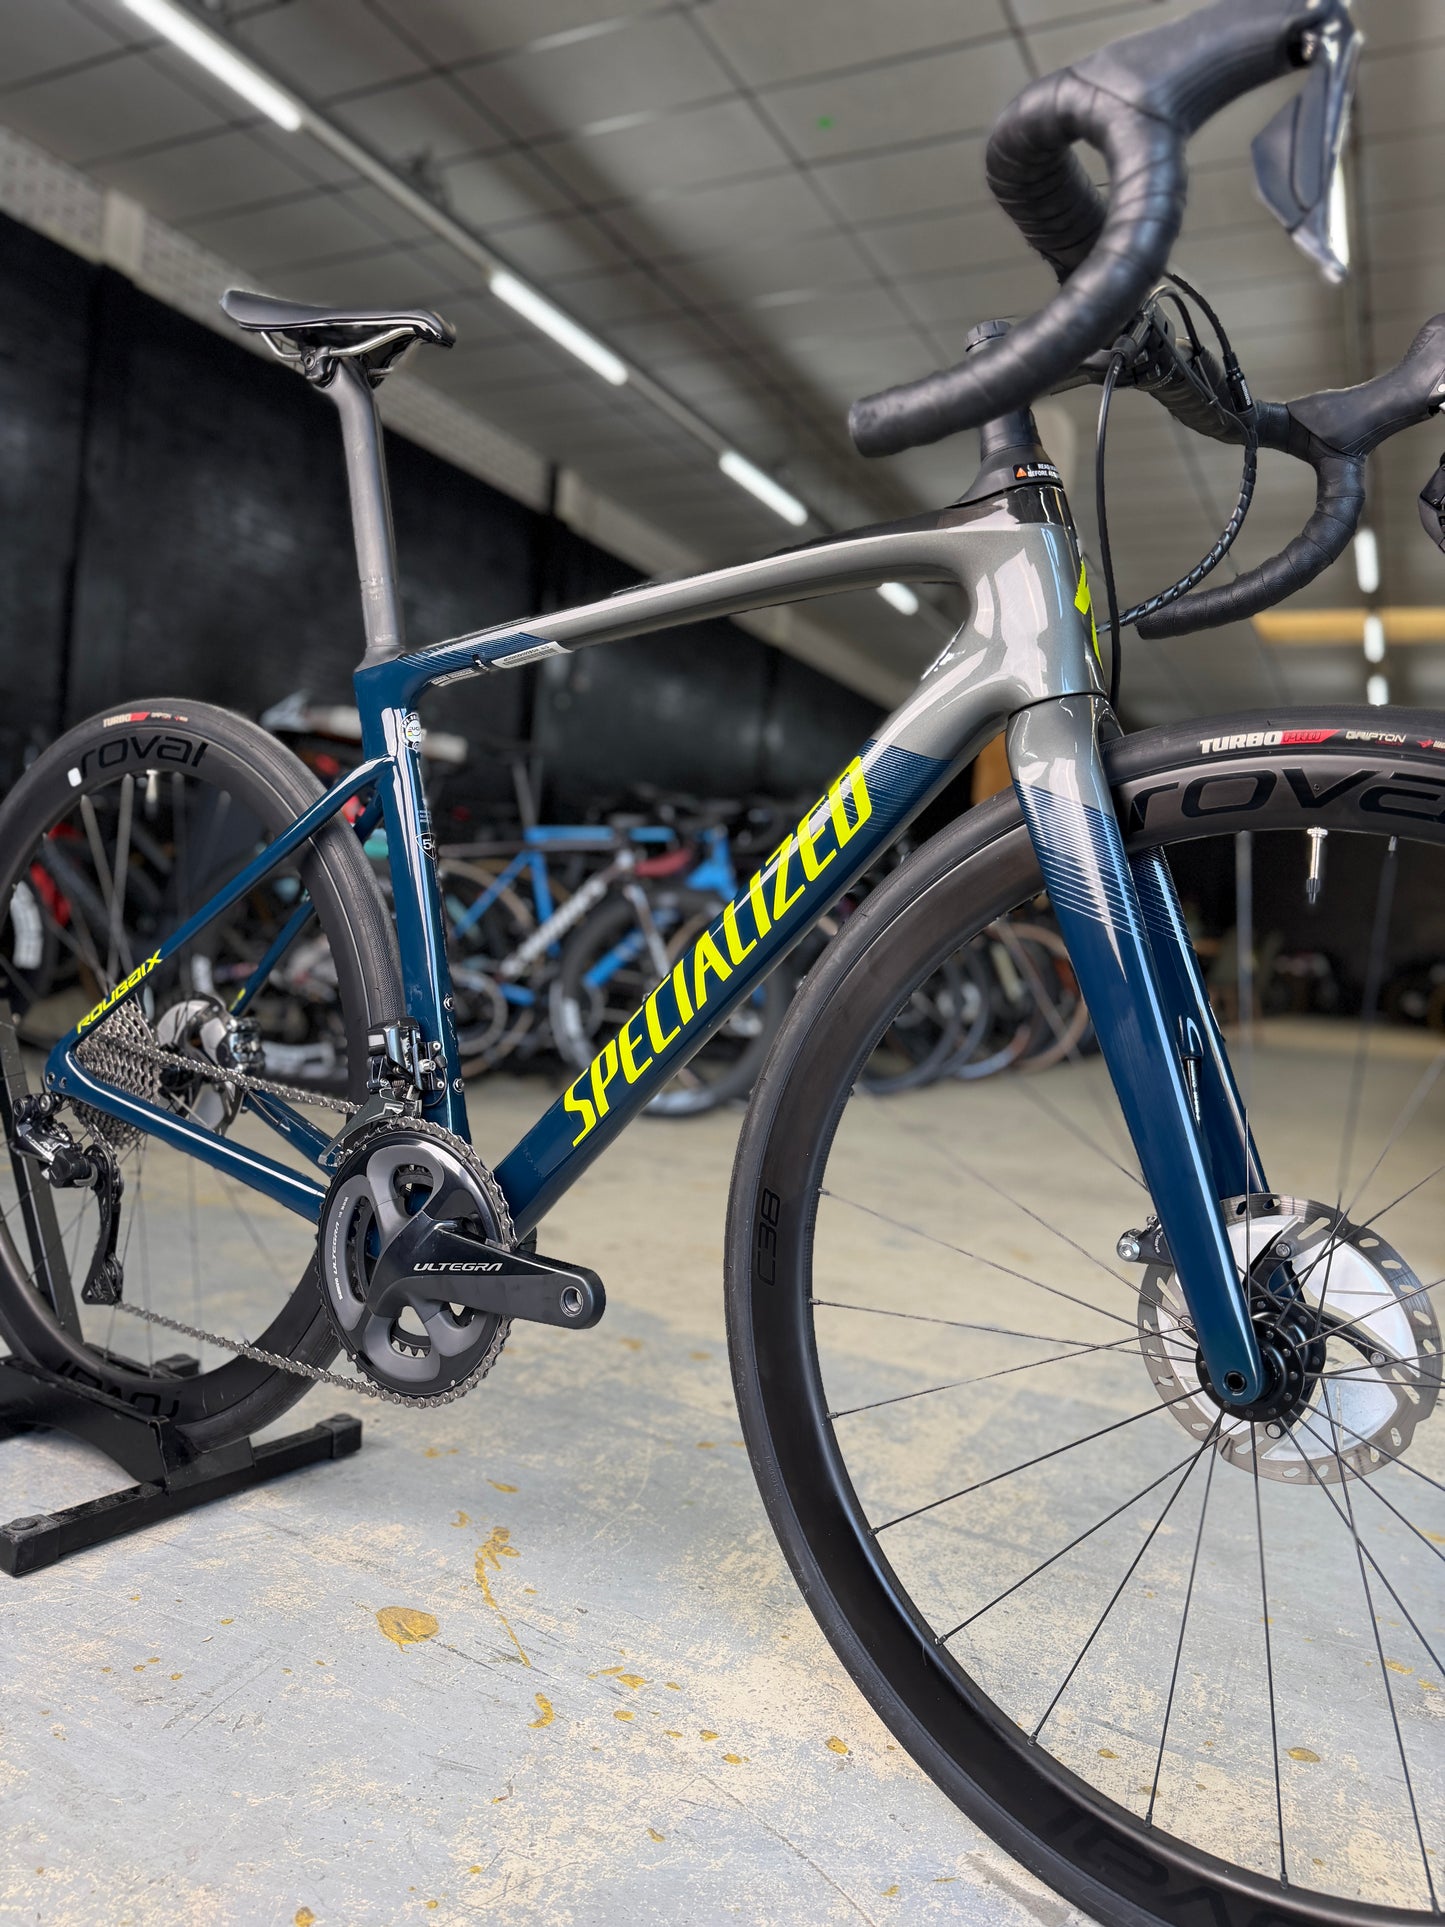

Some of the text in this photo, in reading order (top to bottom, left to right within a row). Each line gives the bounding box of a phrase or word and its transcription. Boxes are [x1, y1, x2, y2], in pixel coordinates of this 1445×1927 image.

[103, 713, 132, 728] TURBO
[1199, 730, 1283, 755] TURBO
[1345, 730, 1407, 744] GRIPTON
[563, 755, 873, 1148] SPECIALIZED
[331, 1221, 340, 1275] ULTEGRA
[756, 1187, 781, 1287] C38
[413, 1261, 503, 1272] ULTEGRA
